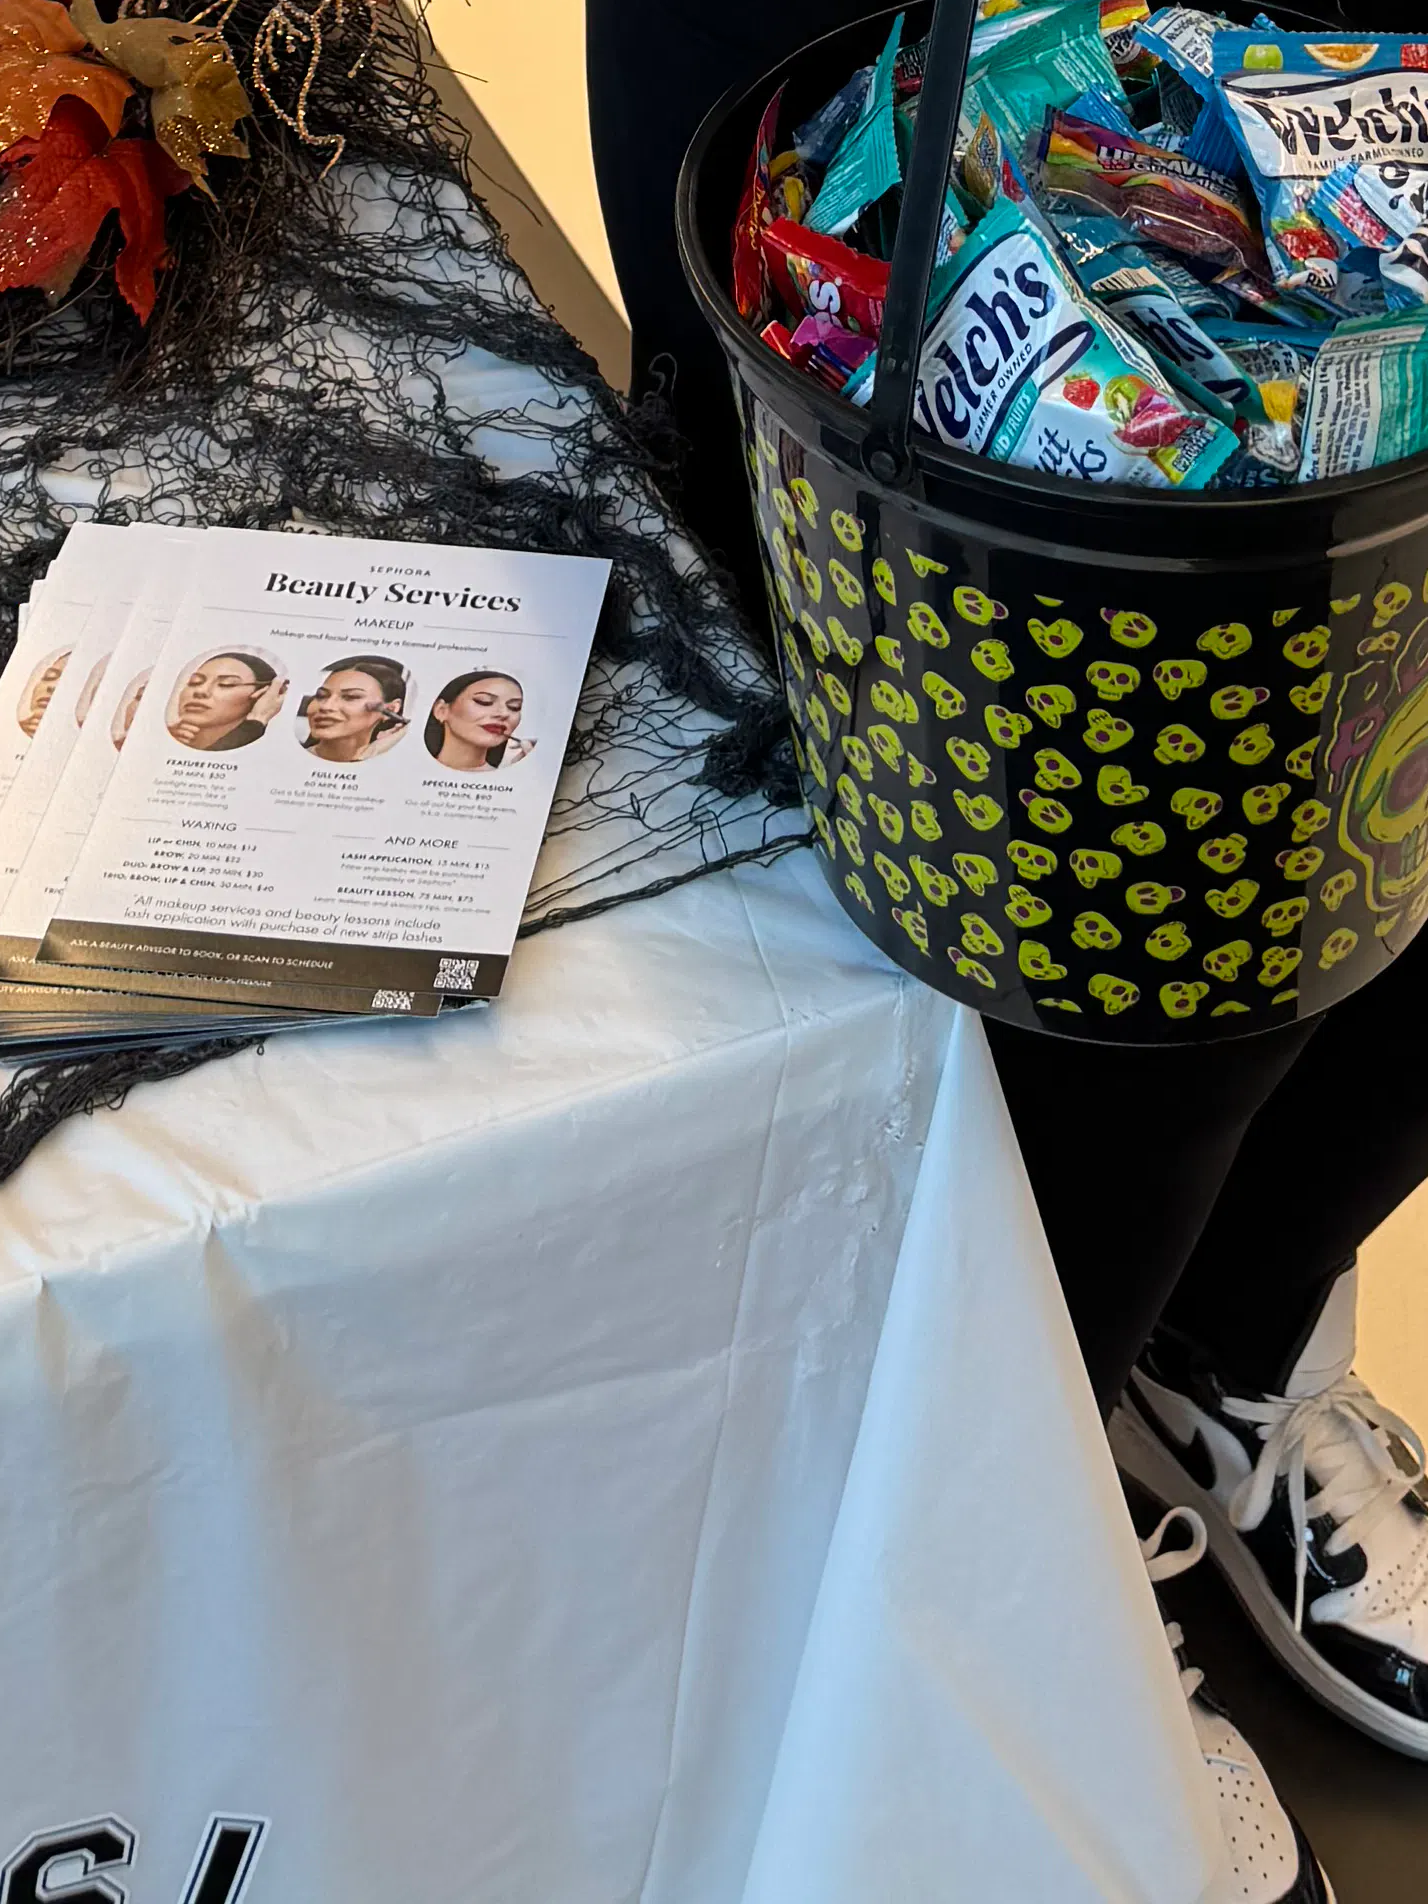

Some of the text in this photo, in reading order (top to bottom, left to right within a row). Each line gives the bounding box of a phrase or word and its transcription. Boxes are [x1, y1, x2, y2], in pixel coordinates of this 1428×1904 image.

[973, 389, 1000, 443] FARMER
[997, 343, 1033, 389] OWNED
[369, 564, 432, 578] SEPHORA
[263, 571, 523, 614] Beauty Services
[353, 616, 415, 632] MAKEUP
[334, 773, 358, 782] FACE
[421, 779, 514, 793] SPECIAL OCCASION
[180, 818, 239, 833] WAXING
[384, 835, 460, 851] AND MORE
[341, 852, 368, 861] LASH
[337, 885, 375, 897] BEAUTY
[155, 895, 208, 914] makeup
[210, 904, 262, 919] services
[264, 907, 292, 922] and
[294, 909, 341, 926] beauty
[343, 913, 392, 928] lessons
[394, 916, 442, 931] include
[123, 907, 445, 946] lash application with purchase of new strip lashes
[70, 938, 90, 948] ASK
[90, 940, 99, 949] A
[99, 940, 136, 952] BEAUTY
[136, 943, 177, 956] ADVISOR
[178, 947, 191, 956] TO
[226, 951, 241, 961] OR
[242, 953, 271, 965] SCAN
[272, 957, 285, 966] TO
[286, 958, 335, 971] SCHEDULE
